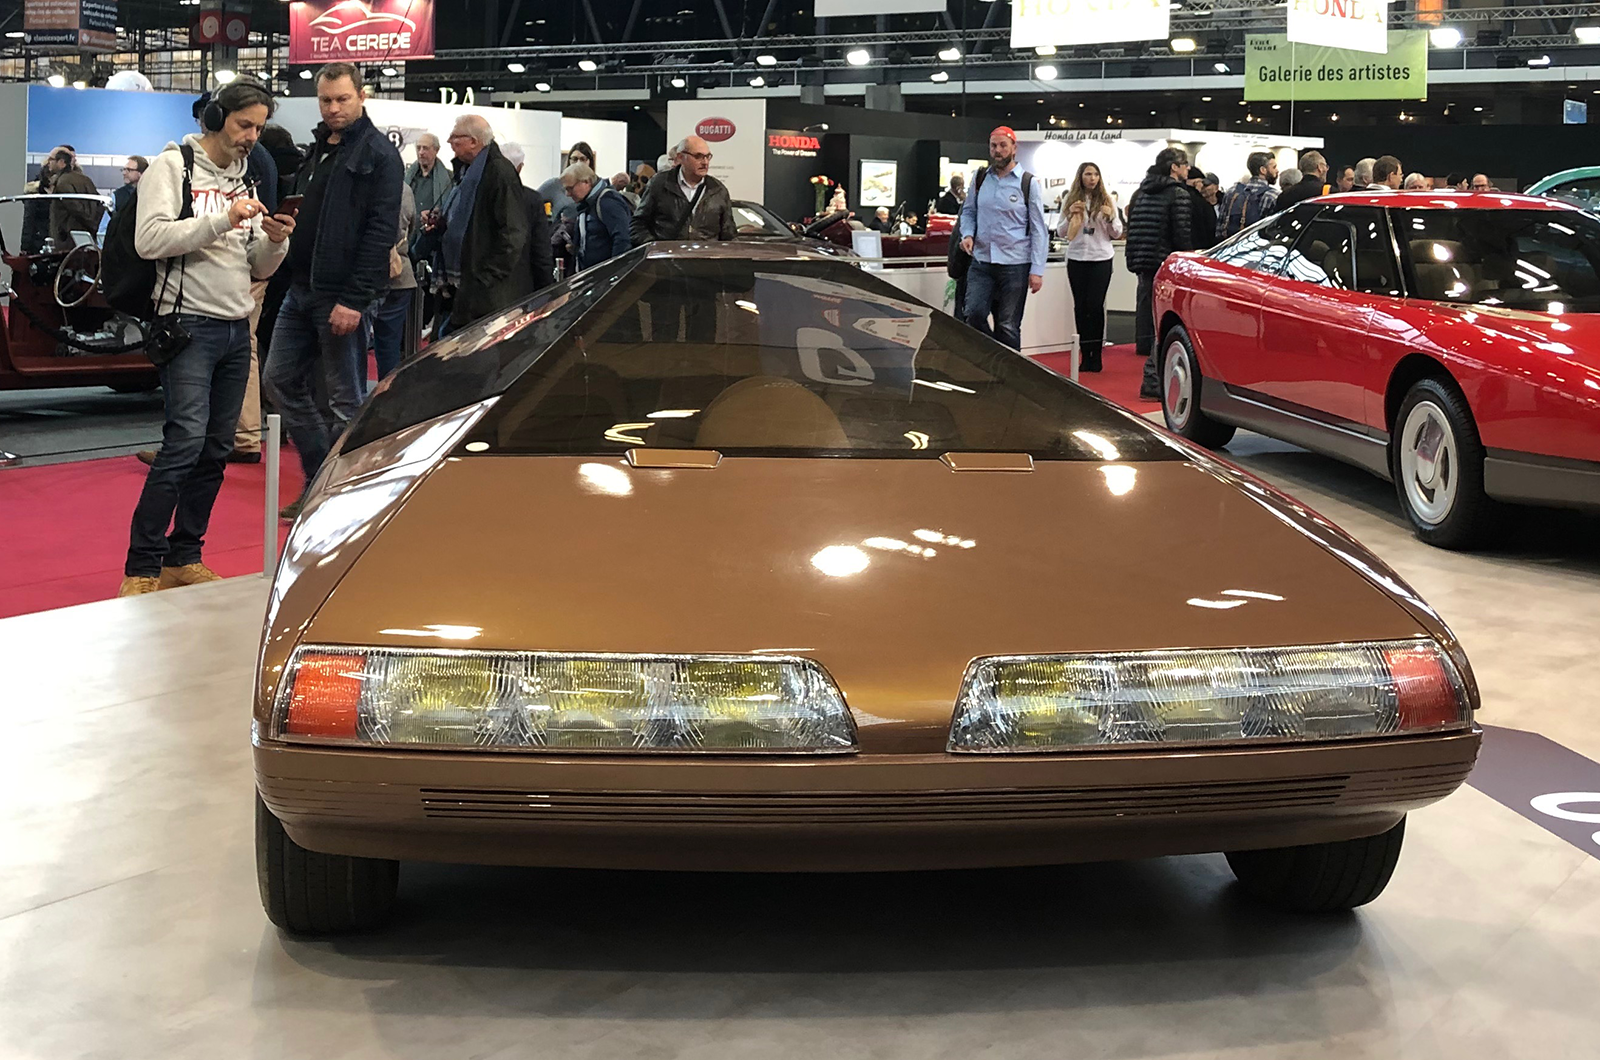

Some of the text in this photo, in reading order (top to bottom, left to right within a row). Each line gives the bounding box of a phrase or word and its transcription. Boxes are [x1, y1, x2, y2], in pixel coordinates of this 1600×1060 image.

[311, 32, 411, 52] TEA CEREDE
[1259, 63, 1410, 82] Galerie des artistes
[700, 125, 731, 135] BUGATTI
[1044, 129, 1074, 140] Honda
[768, 135, 821, 149] HONDA
